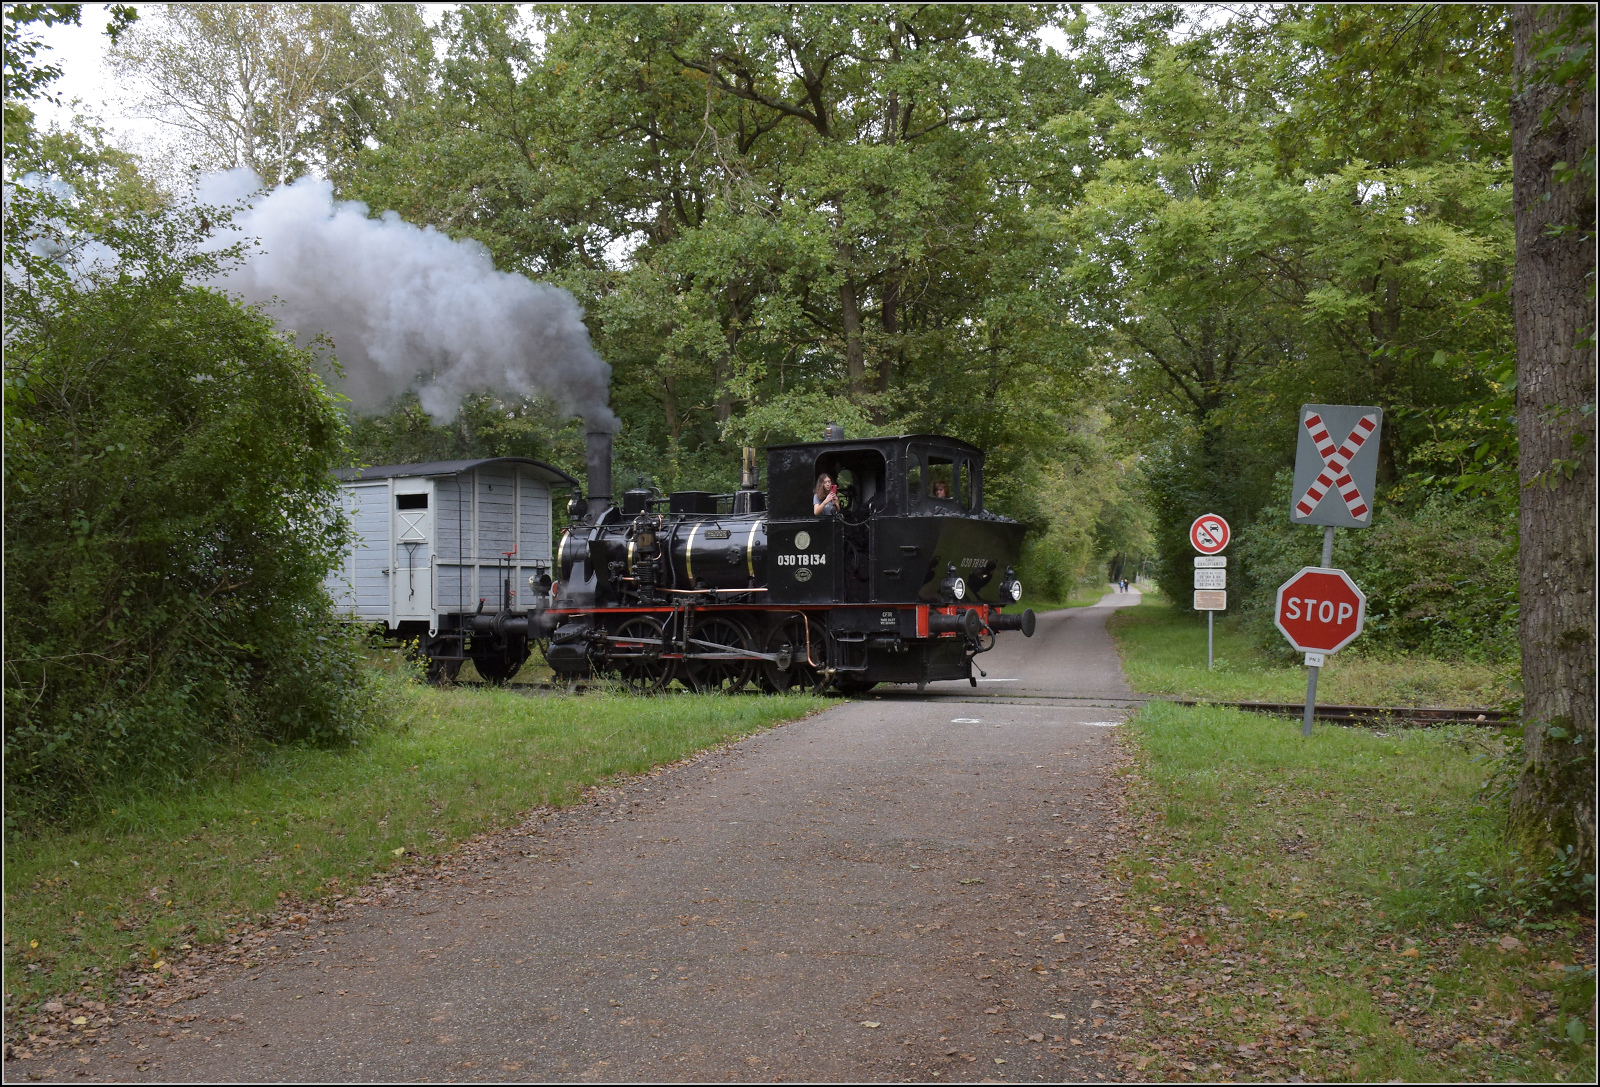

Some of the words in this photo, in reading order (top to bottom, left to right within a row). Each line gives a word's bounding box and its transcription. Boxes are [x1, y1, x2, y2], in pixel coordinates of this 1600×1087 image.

[778, 555, 796, 566] 030
[797, 554, 809, 566] TB
[811, 554, 826, 565] 134
[1285, 596, 1353, 625] STOP
